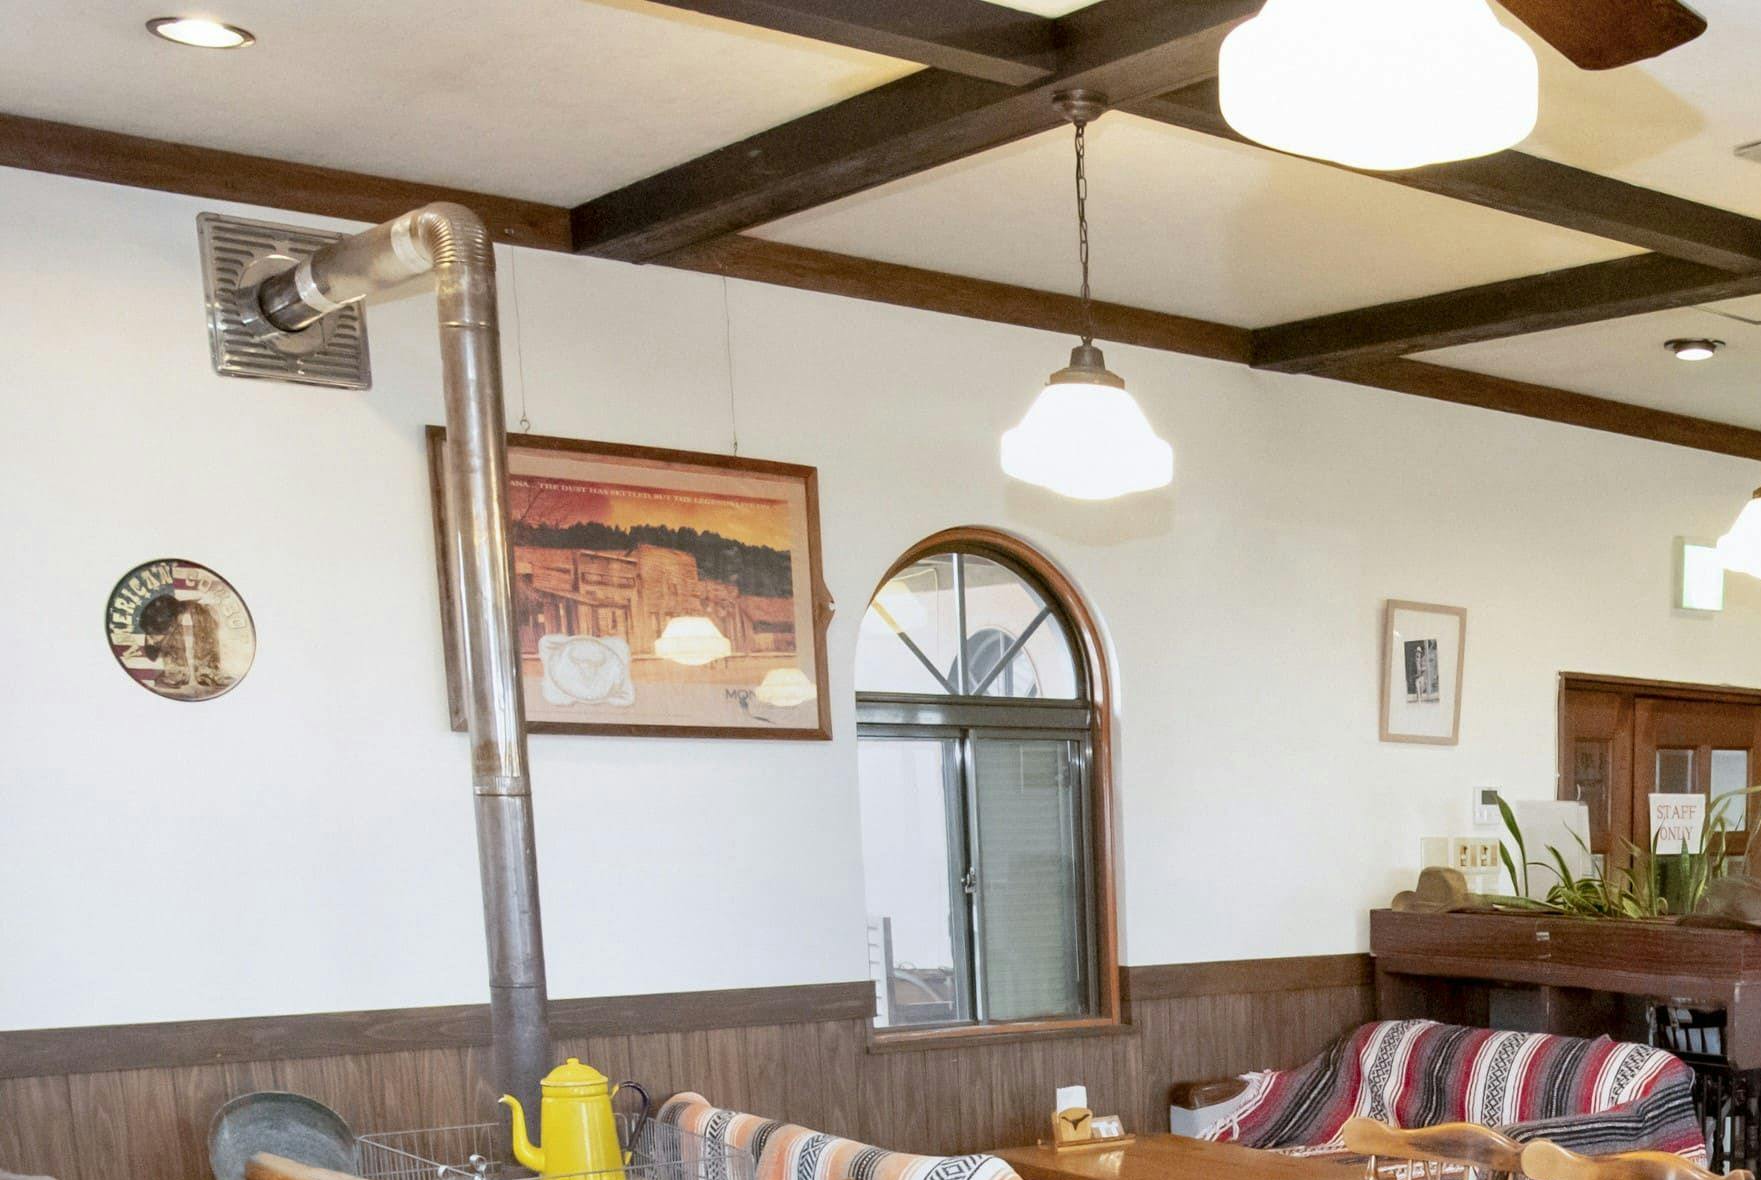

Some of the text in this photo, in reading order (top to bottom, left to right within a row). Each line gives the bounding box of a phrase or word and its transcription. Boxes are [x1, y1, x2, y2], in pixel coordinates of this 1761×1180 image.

[109, 563, 174, 660] AMERICAN
[1657, 804, 1697, 819] STAFF
[1660, 826, 1692, 840] ONLY
